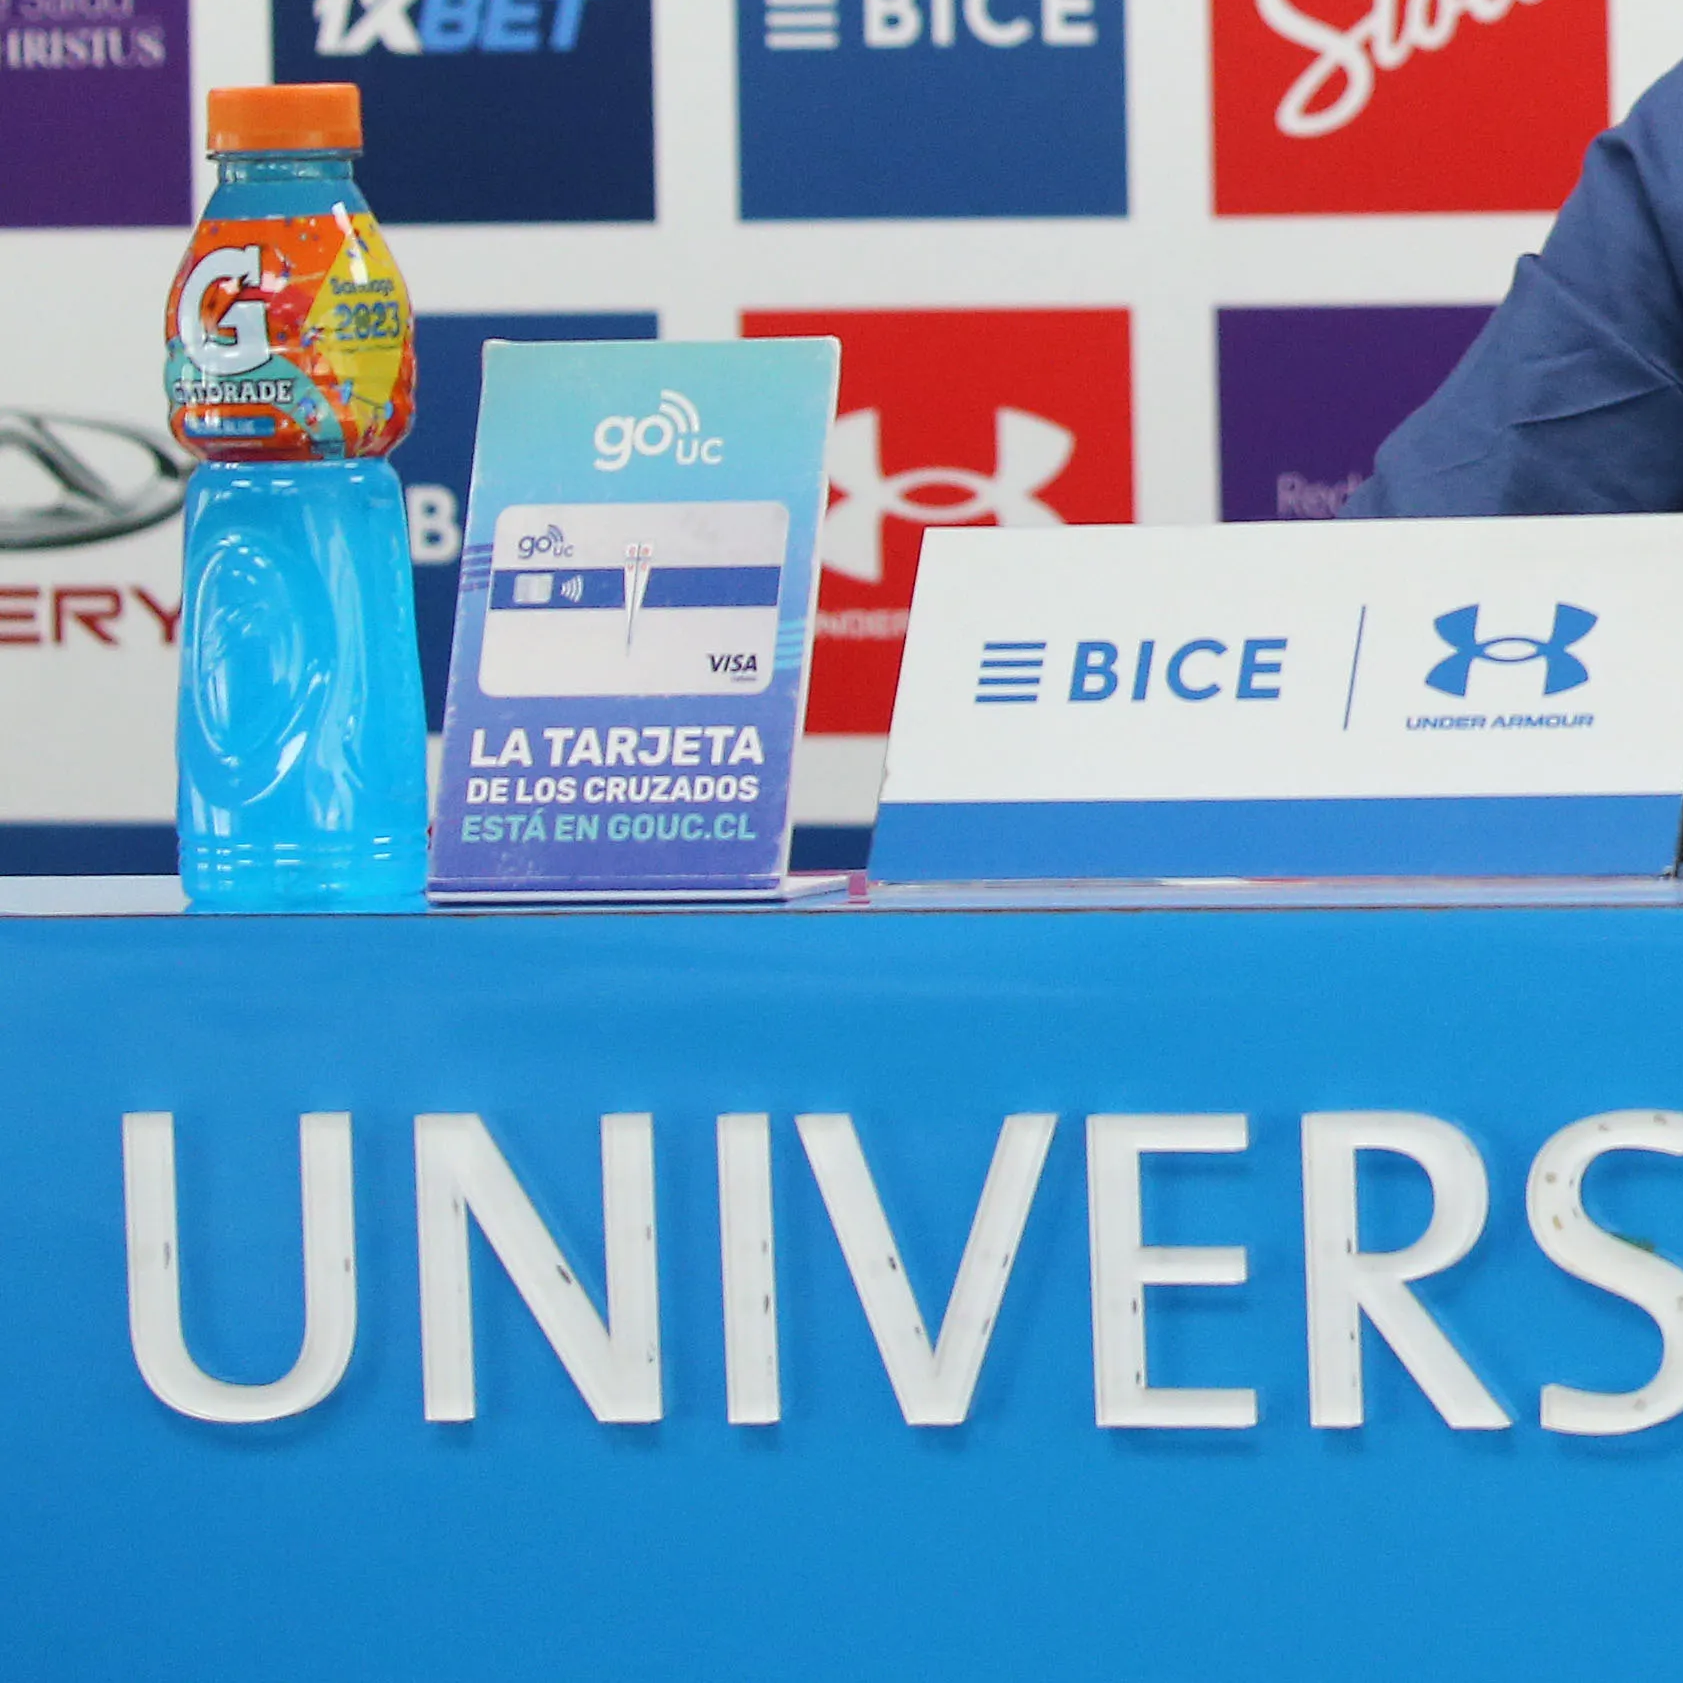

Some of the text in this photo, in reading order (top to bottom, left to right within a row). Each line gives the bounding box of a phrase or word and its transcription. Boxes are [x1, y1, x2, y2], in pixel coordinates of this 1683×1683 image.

[178, 244, 272, 376] G
[707, 654, 758, 672] VISA
[1069, 638, 1287, 702] BICE
[1406, 714, 1594, 730] UNDER ARMOUR
[470, 725, 765, 767] LA TARJETA
[466, 774, 760, 805] DE LOS CRUZADOS
[461, 808, 756, 843] ESTÁ EN GOUC.CL
